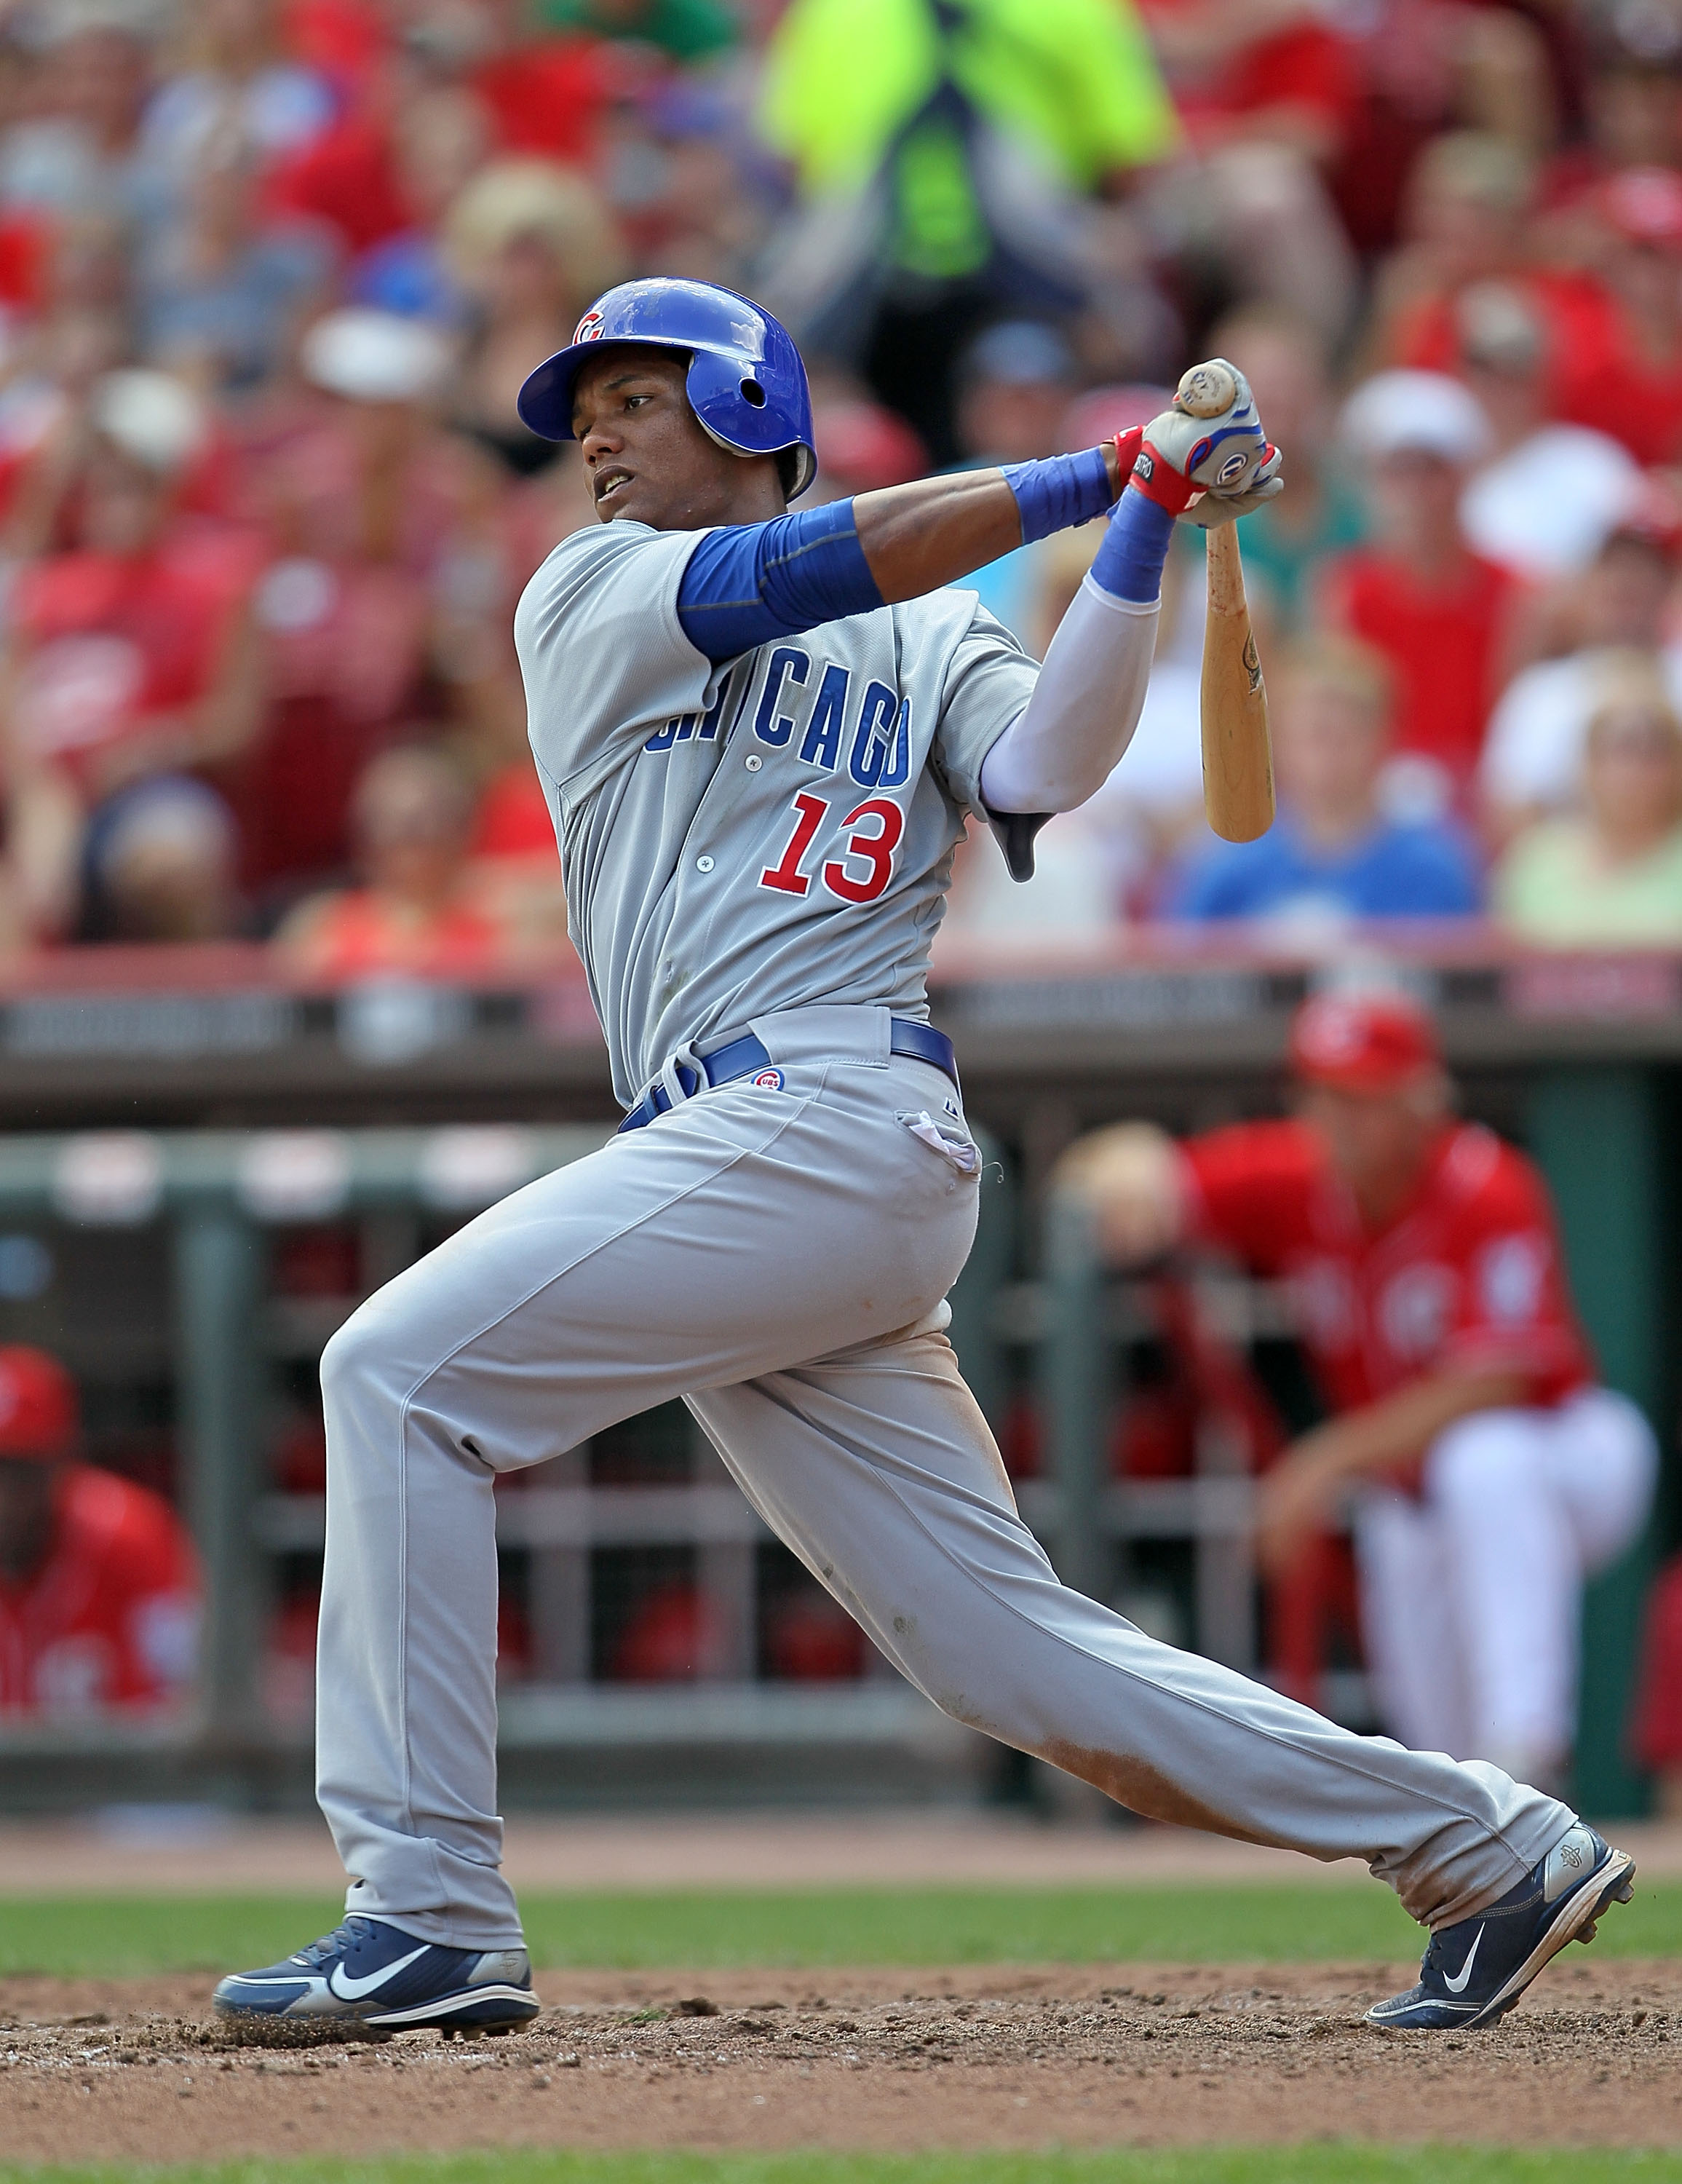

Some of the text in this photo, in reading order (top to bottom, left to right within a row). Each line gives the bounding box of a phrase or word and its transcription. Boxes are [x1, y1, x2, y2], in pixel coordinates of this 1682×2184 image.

[1133, 454, 1152, 478] STRO
[643, 646, 913, 790] CAGO
[757, 789, 905, 904] 13
